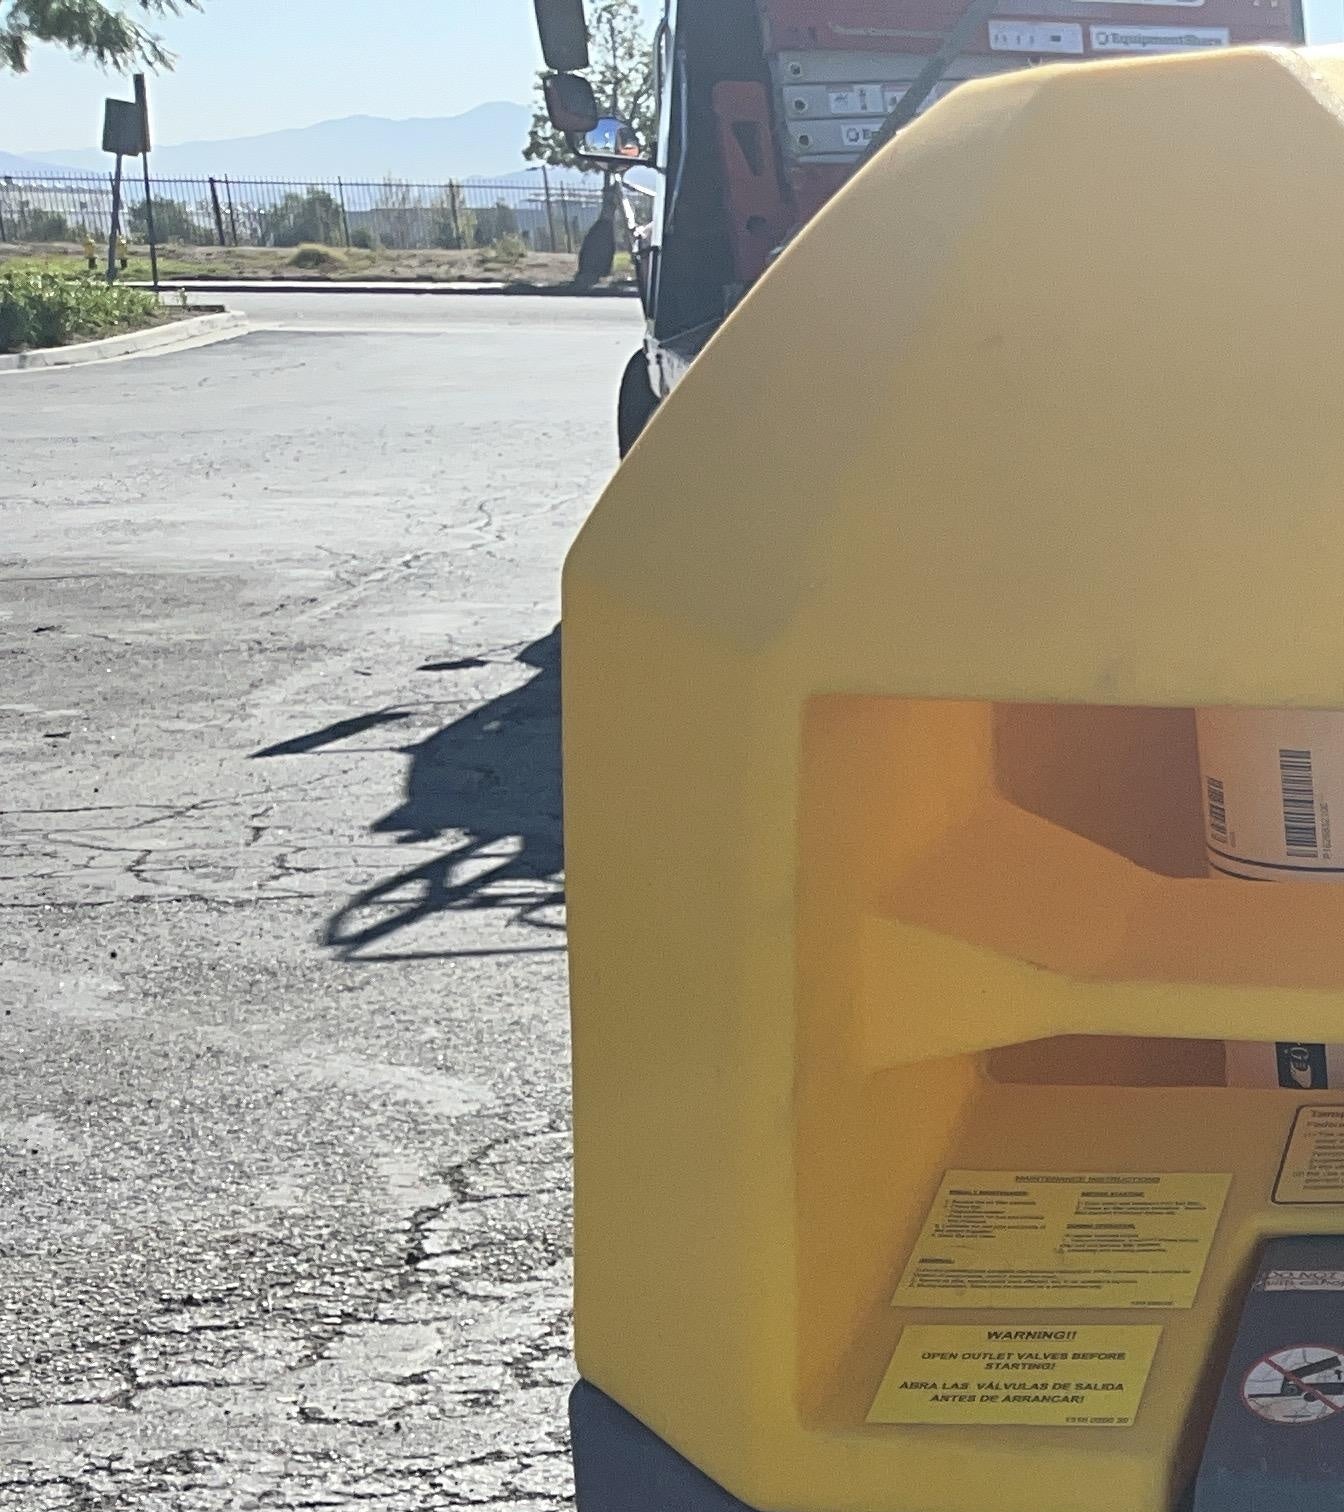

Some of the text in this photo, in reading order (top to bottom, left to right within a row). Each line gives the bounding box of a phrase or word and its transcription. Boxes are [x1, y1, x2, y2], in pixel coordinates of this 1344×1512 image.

[986, 1330, 1078, 1341] WARNING!!
[920, 1351, 1126, 1361] OPEN OUTLET VALVES BEFORE
[983, 1362, 1057, 1370] STARTING!
[898, 1380, 939, 1391] ABRA
[941, 1381, 969, 1391] LAS
[1052, 1382, 1072, 1391] DE
[1074, 1382, 1125, 1392] SALIDA
[929, 1394, 977, 1403] ANTES
[979, 1394, 999, 1403] DE
